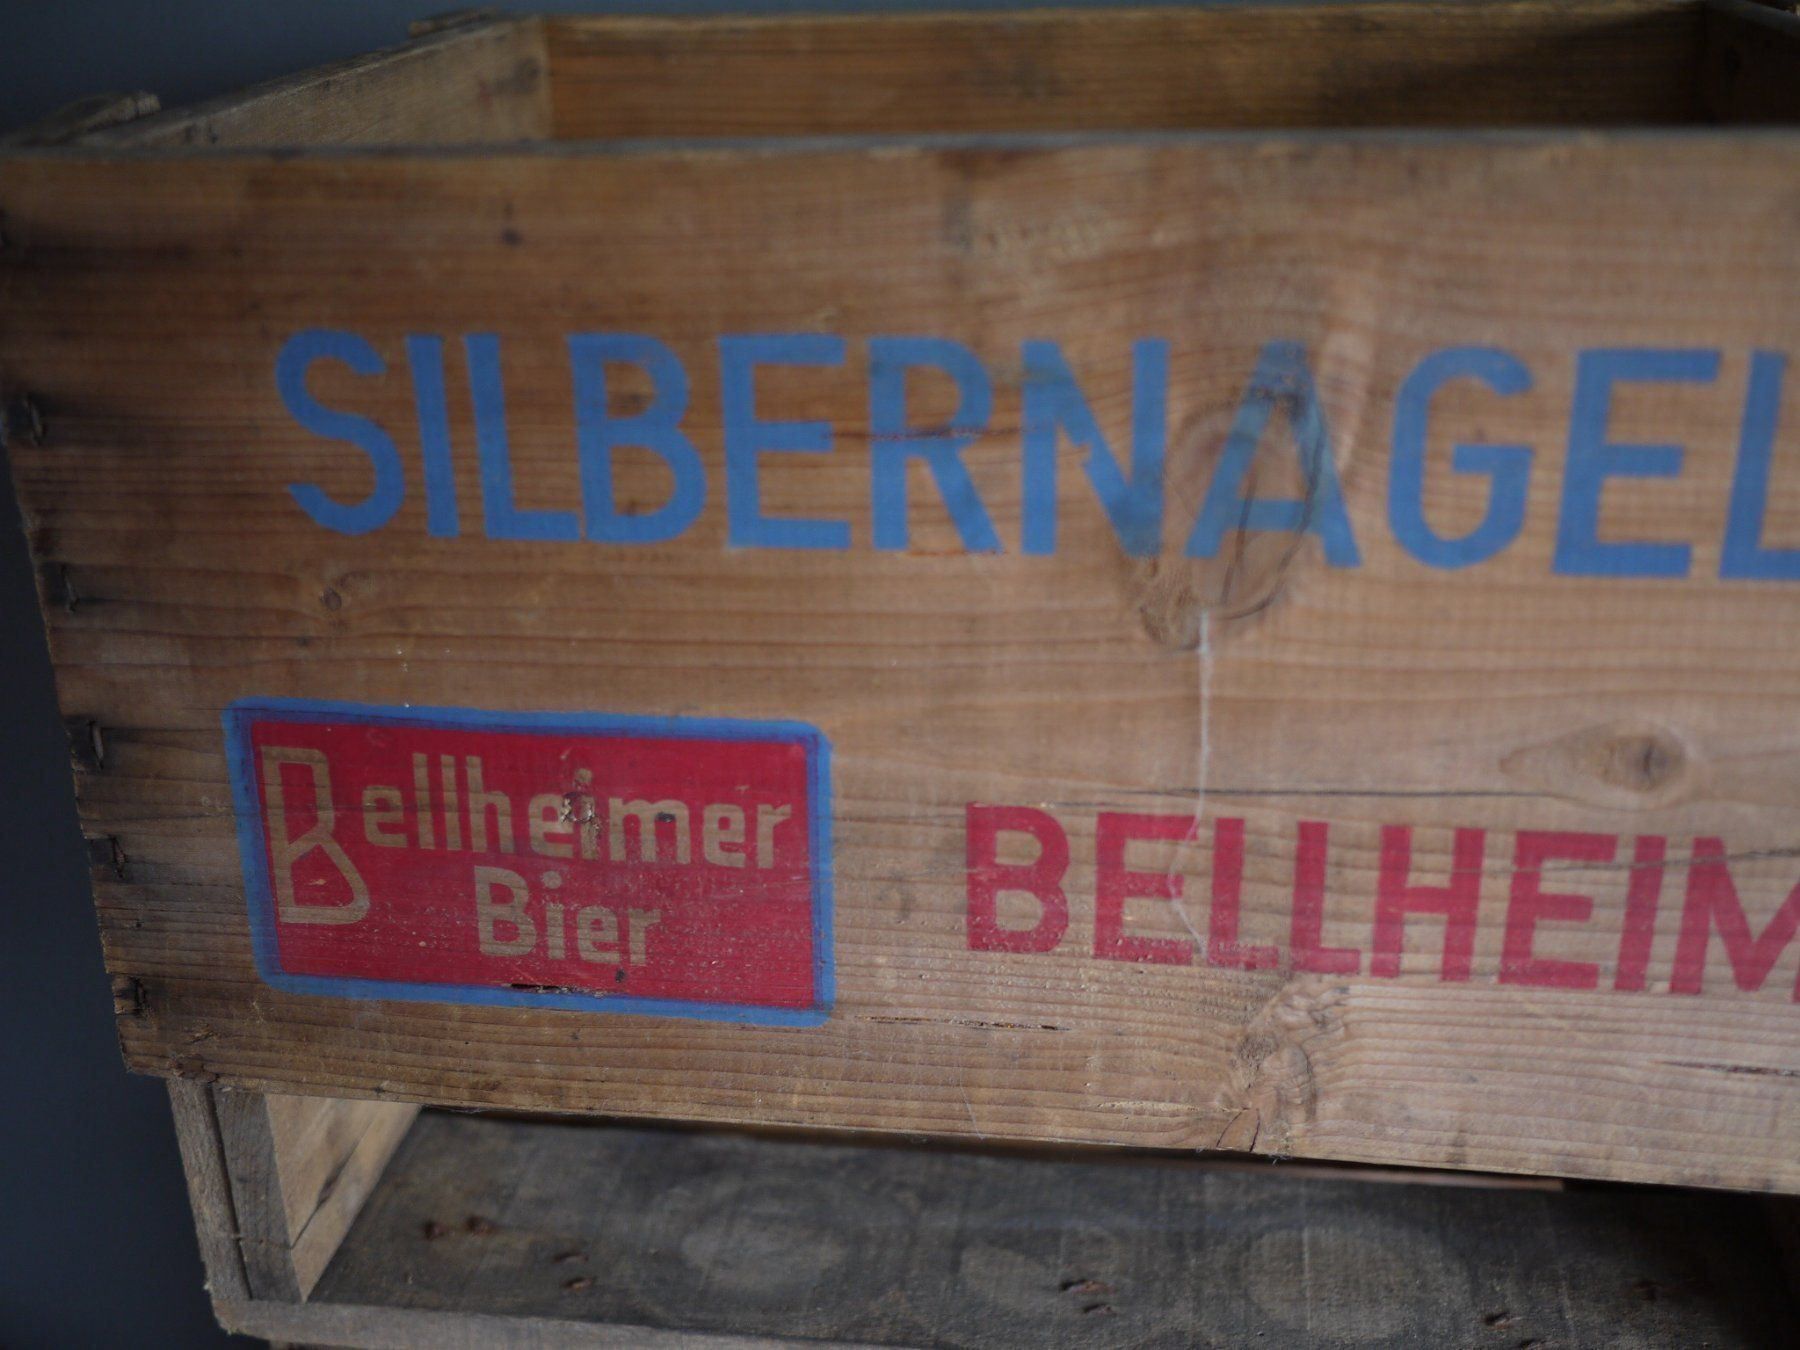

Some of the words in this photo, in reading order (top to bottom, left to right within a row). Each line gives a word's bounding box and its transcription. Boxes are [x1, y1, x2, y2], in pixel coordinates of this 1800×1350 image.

[275, 328, 1800, 580] SILBERNAGEL
[260, 745, 793, 924] Bellheimer
[473, 865, 662, 966] Bier
